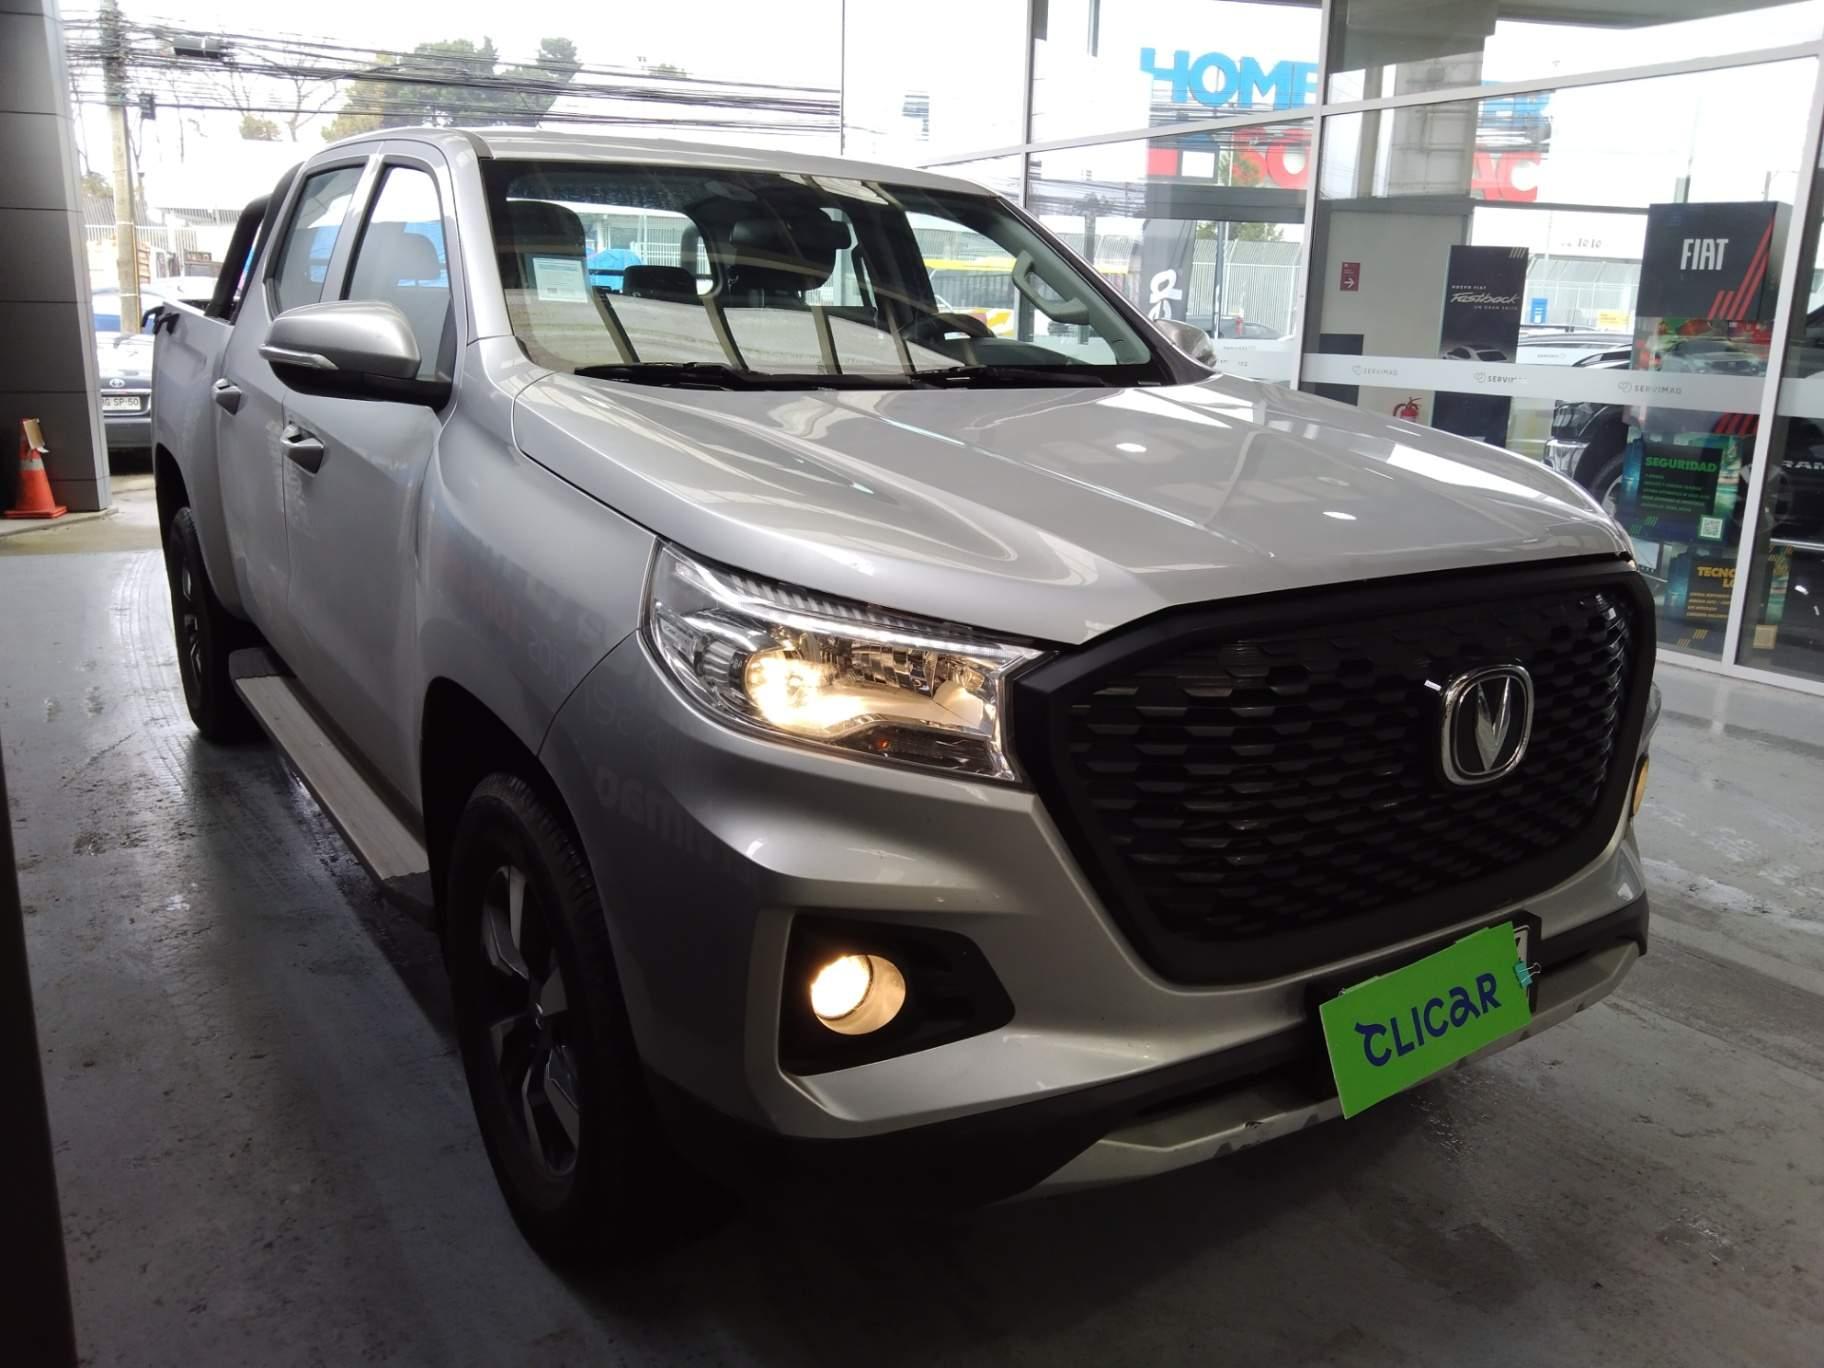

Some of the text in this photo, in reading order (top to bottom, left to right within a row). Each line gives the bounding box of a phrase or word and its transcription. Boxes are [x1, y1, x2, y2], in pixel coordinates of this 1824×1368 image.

[1680, 238, 1729, 271] FIAT
[1450, 291, 1520, 304] Fastback
[1645, 456, 1718, 473] SEGURIDAD
